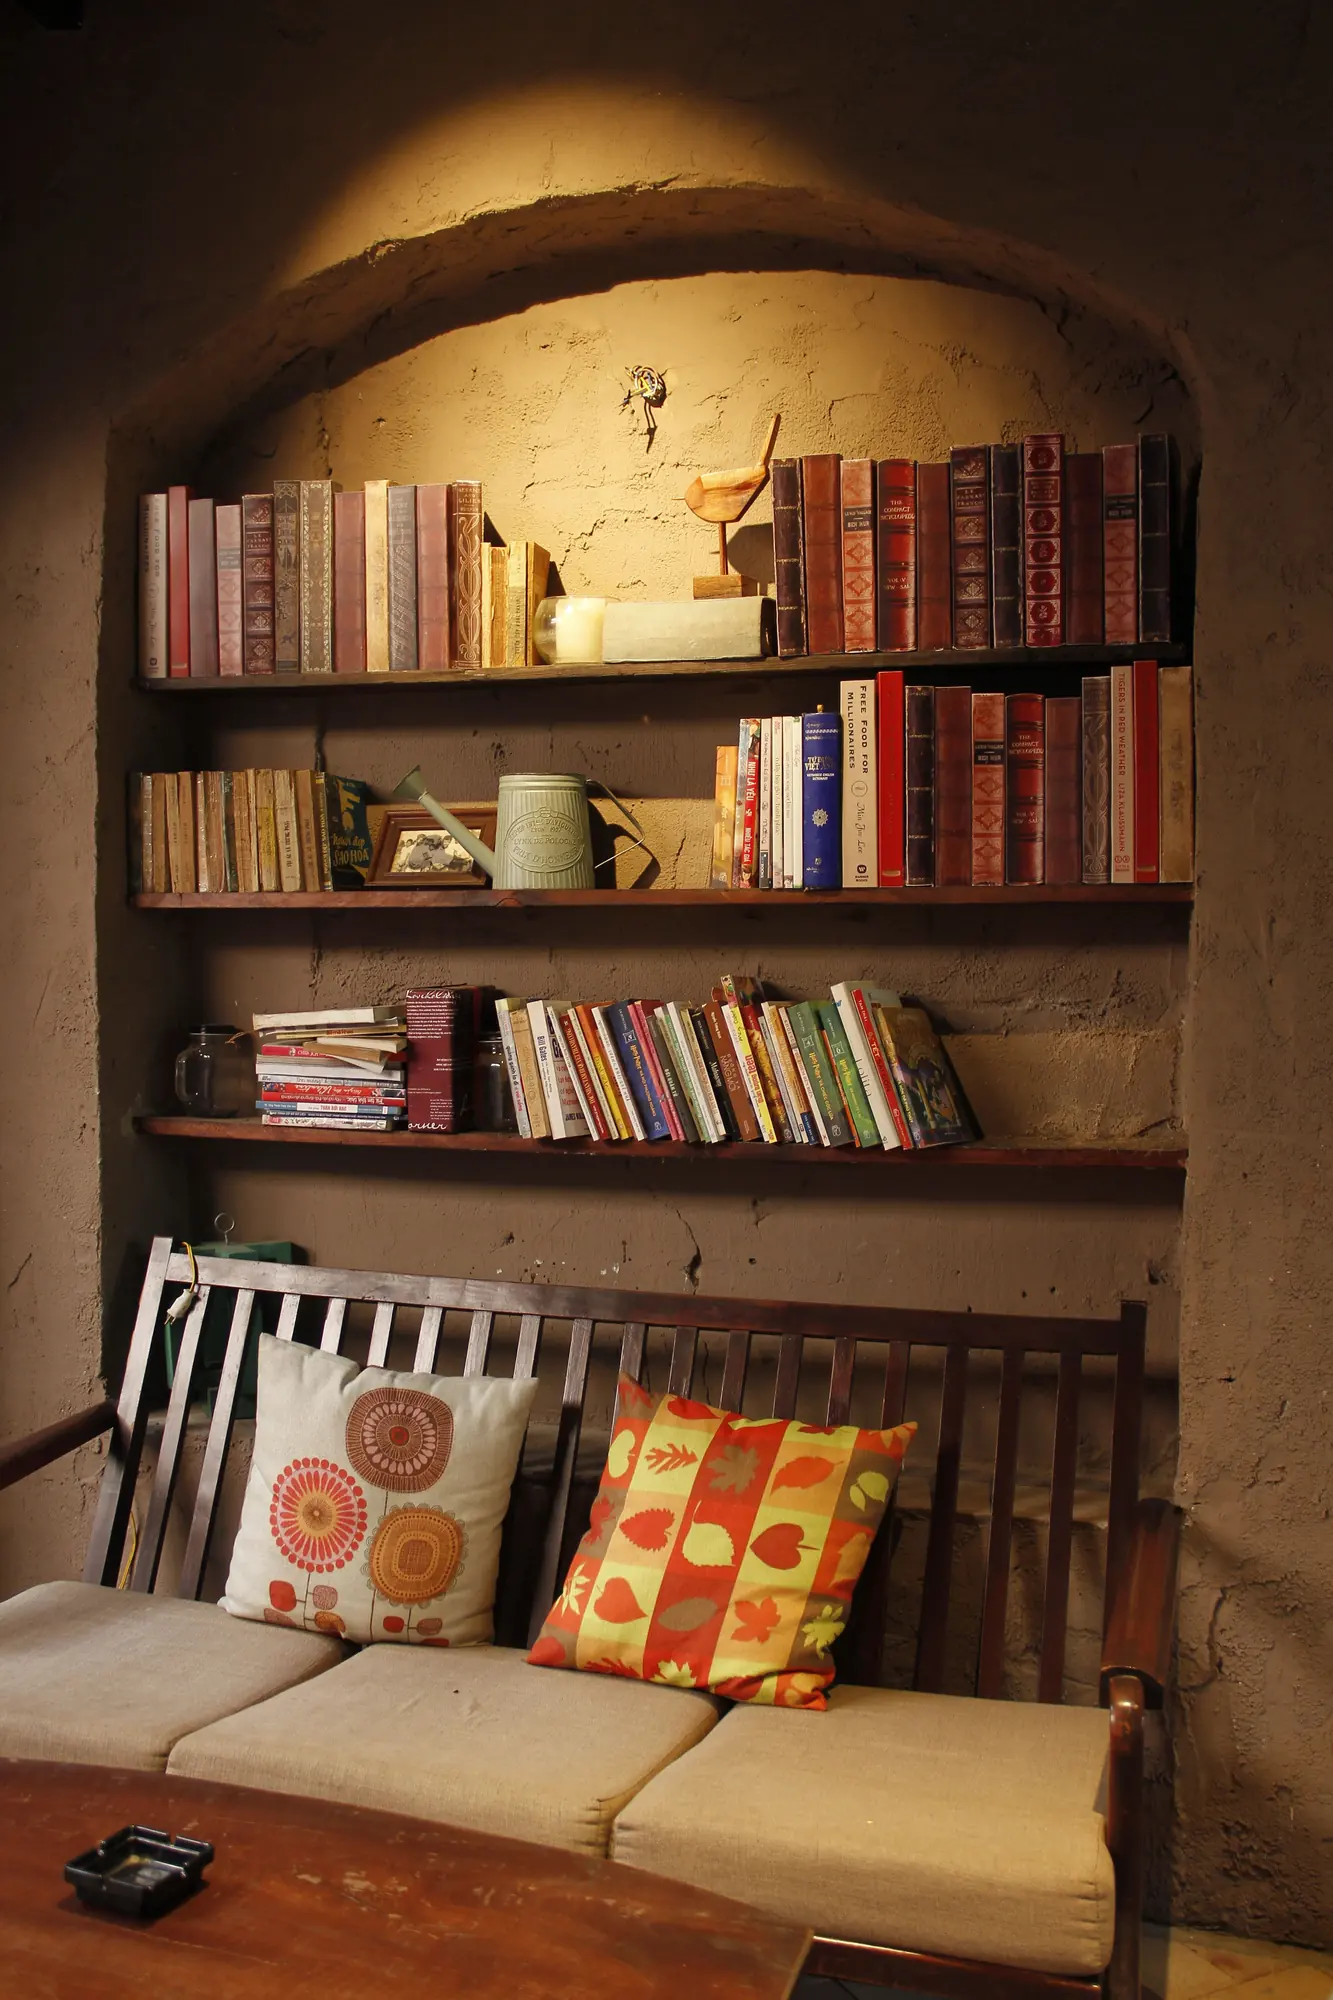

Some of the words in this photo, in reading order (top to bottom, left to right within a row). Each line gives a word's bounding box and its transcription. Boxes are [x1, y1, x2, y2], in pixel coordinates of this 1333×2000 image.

[1118, 673, 1126, 703] TIGERS
[860, 685, 868, 713] FREE
[1118, 705, 1126, 714] IN
[847, 691, 856, 769] MILLIONAIRES
[1118, 716, 1126, 733] RED
[1118, 735, 1126, 776] WEATHER
[747, 761, 756, 776] NHƯ
[747, 777, 756, 786] LÀ
[745, 787, 756, 801] YÊU
[1118, 783, 1126, 800] LIZA
[856, 803, 866, 821] Min
[855, 823, 866, 837] Jin
[1118, 801, 1126, 852] KLAUSSMANN
[857, 840, 866, 854] Lee
[334, 849, 349, 867] SAO
[537, 1035, 545, 1045] Bill
[538, 1045, 548, 1061] Gates
[295, 1082, 332, 1094] Valentine
